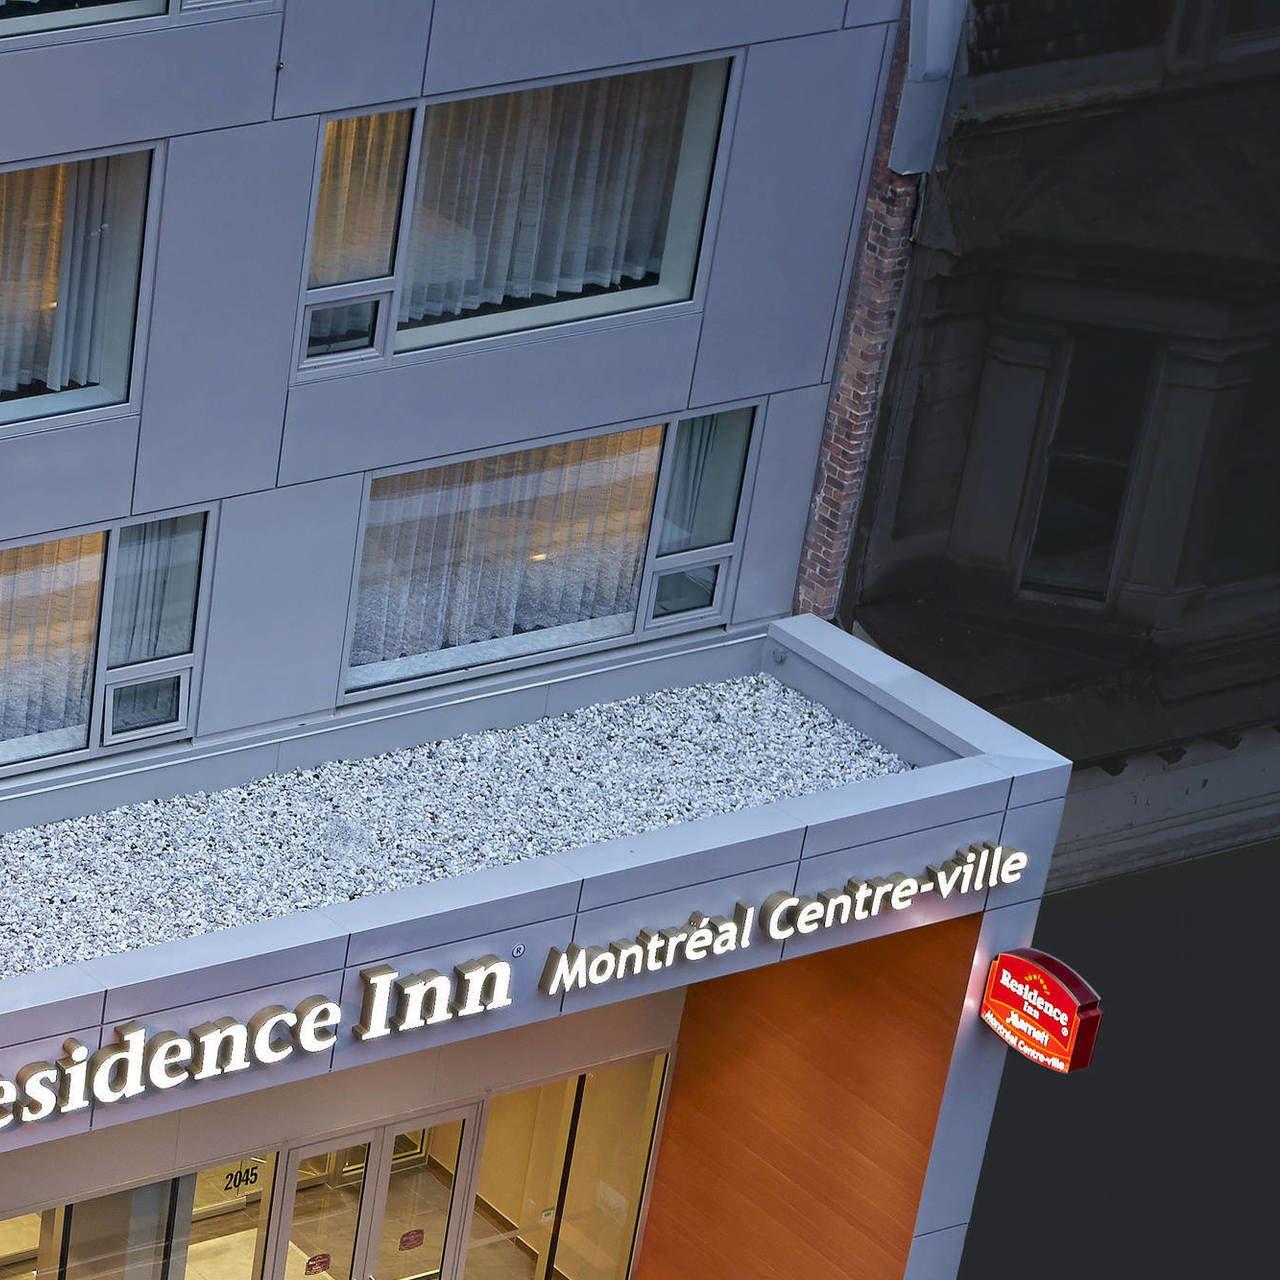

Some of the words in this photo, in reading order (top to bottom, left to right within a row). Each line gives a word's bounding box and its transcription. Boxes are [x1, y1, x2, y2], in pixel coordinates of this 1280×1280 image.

[360, 956, 513, 1042] Inn
[547, 906, 755, 996] Montréal
[769, 846, 1029, 940] Centre-ville
[1000, 969, 1069, 1026] Residence
[1022, 1001, 1040, 1020] Inn
[224, 1166, 258, 1191] 2045
